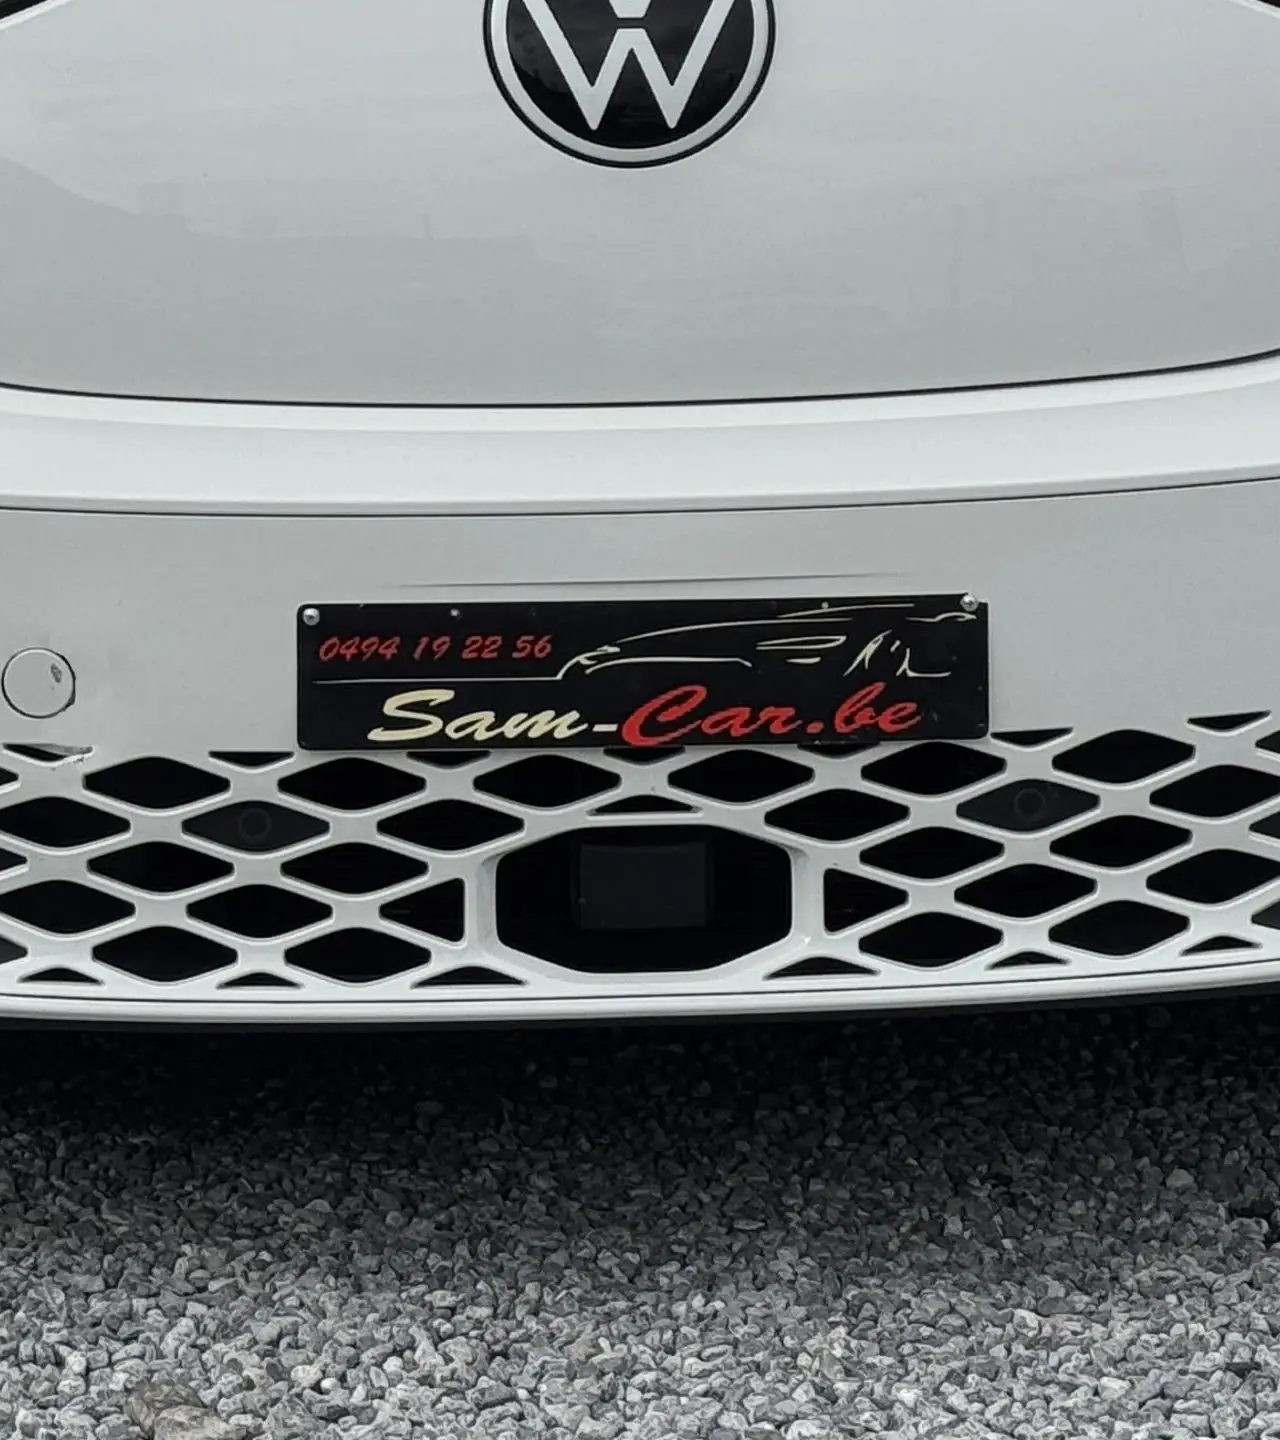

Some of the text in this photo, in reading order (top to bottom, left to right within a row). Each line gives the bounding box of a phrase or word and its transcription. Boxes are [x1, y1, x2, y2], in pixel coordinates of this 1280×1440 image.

[318, 633, 553, 662] 0494 19 22 56
[367, 681, 923, 748] Sam-Car.be
